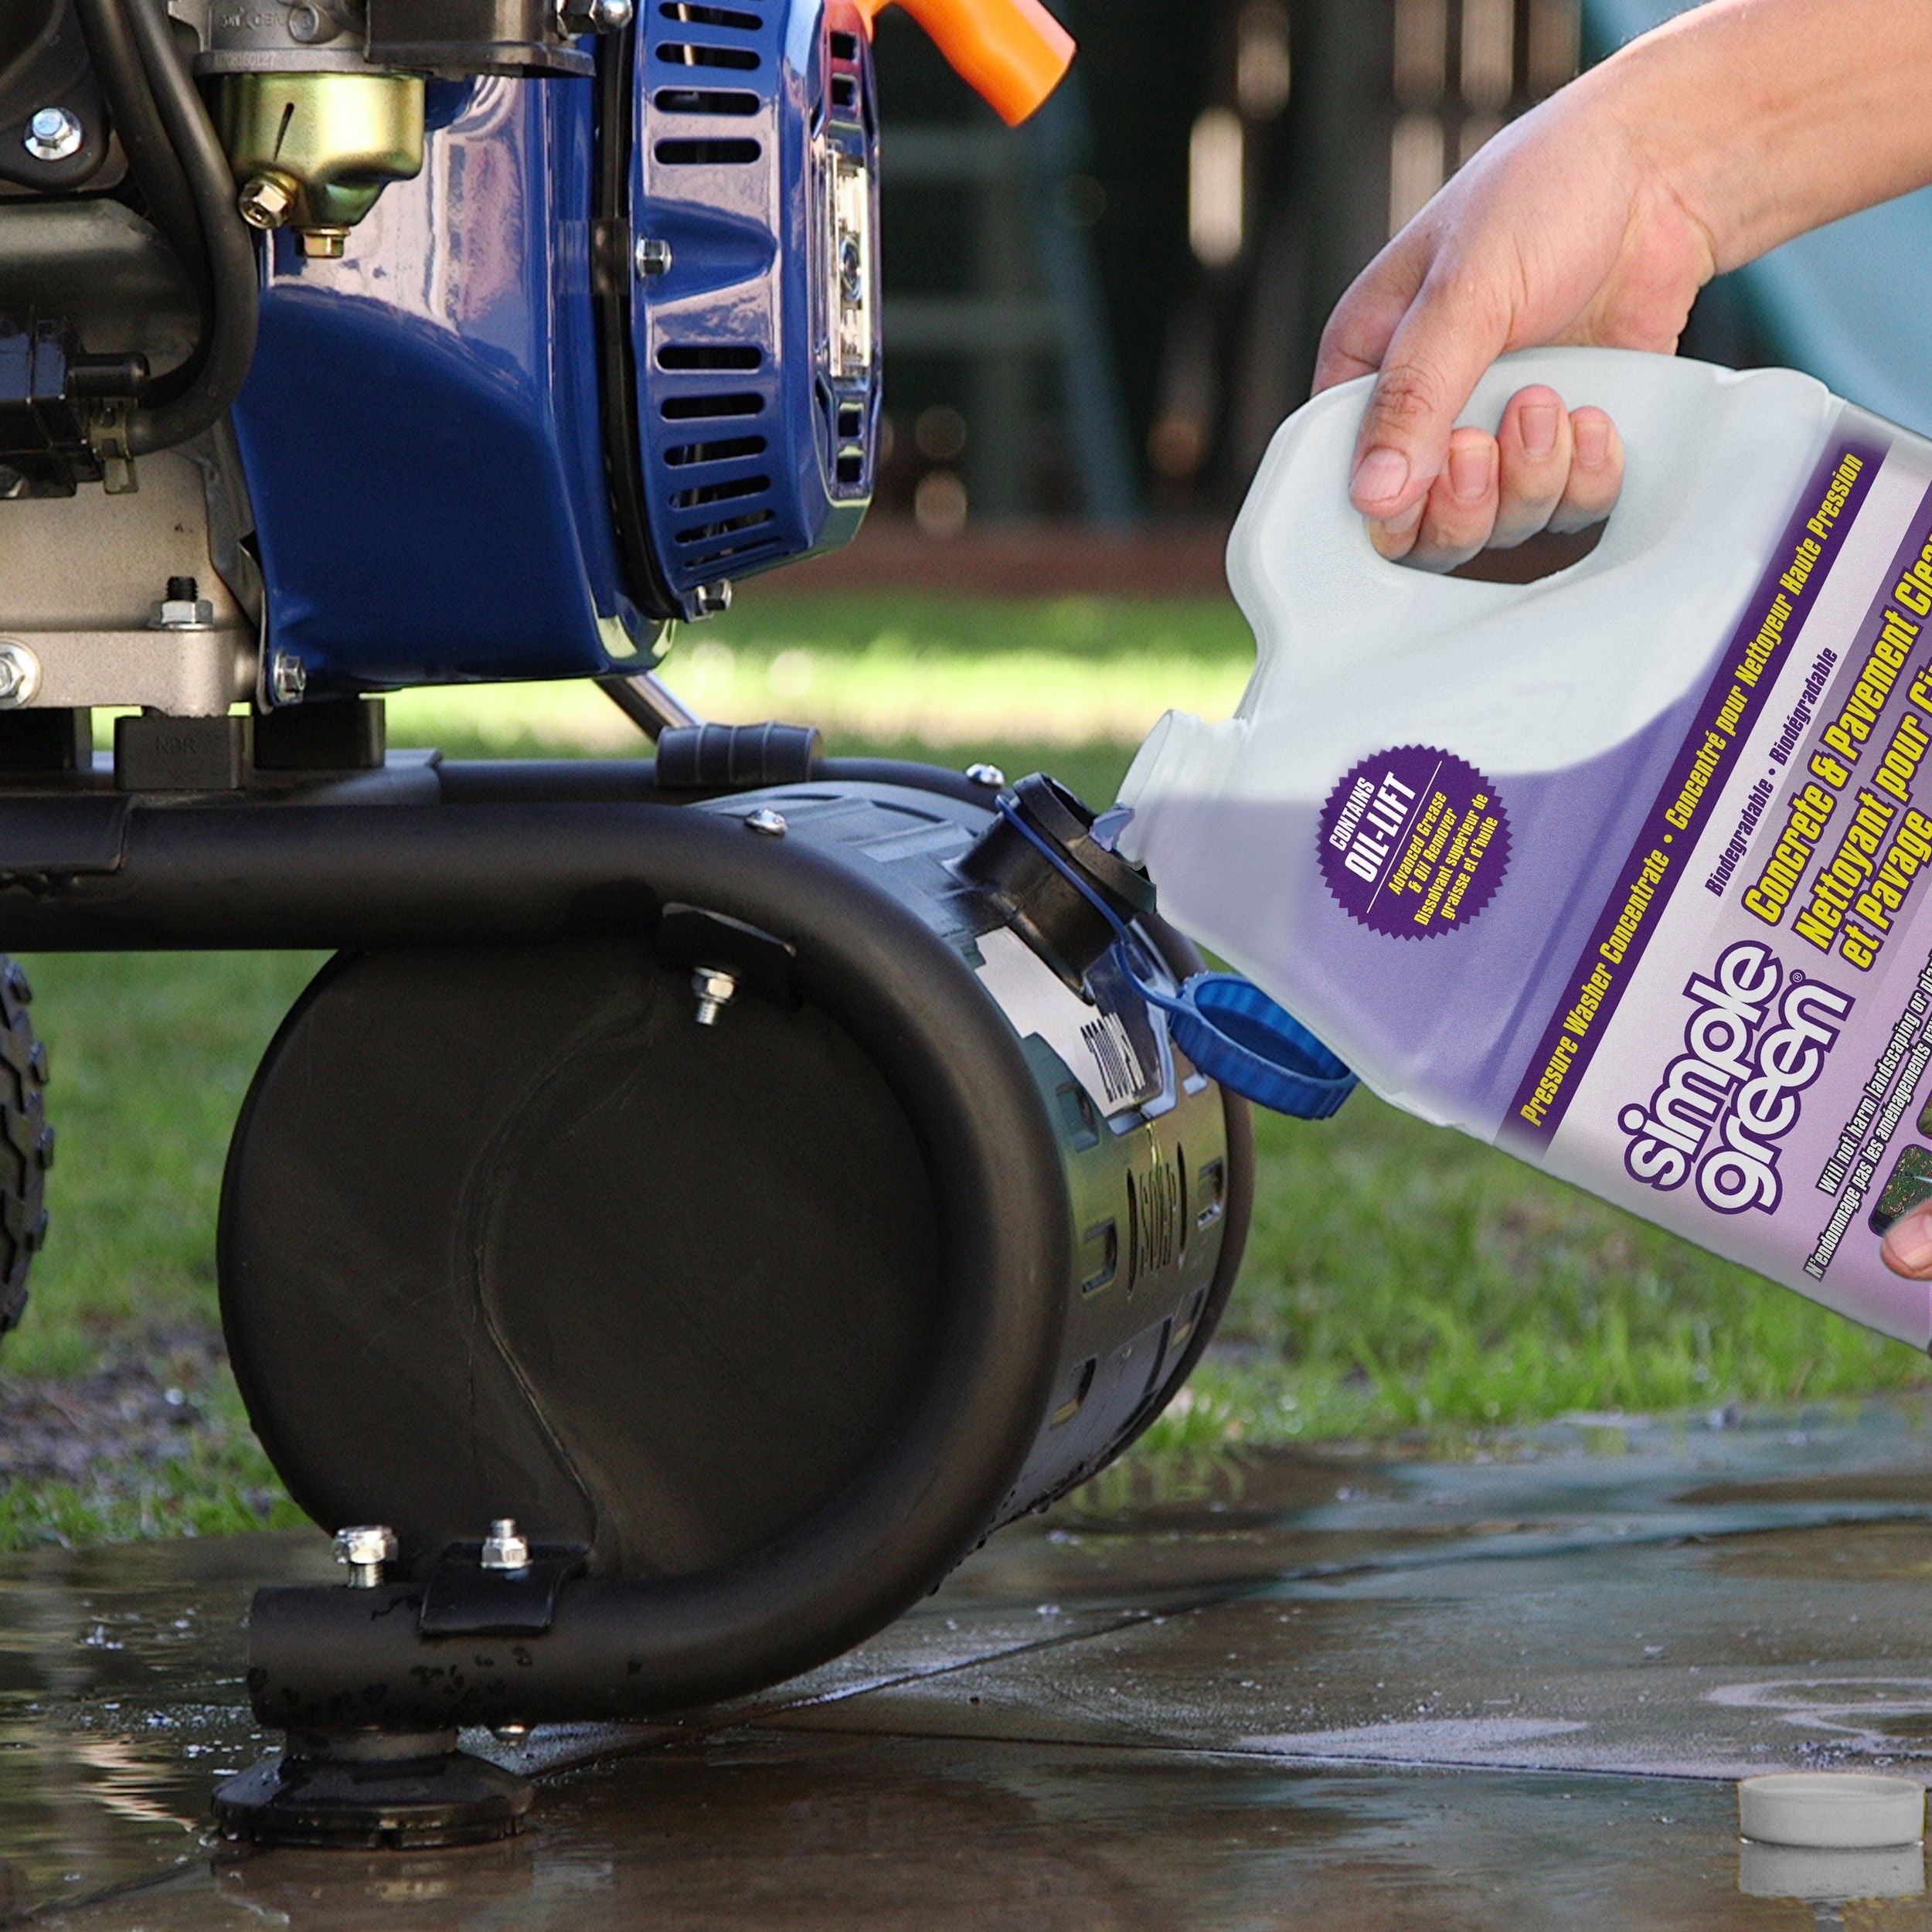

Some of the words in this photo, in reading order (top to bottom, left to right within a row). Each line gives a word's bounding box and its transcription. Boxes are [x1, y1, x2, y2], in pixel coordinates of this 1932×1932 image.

[1824, 611, 1918, 760] Pavement
[1329, 777, 1374, 851] CONTAINS
[1345, 771, 1415, 882] OIL-LIFT
[1521, 1036, 1578, 1125] Pressure
[1563, 963, 1612, 1036] Washer
[1600, 849, 1669, 964] Concentrate
[1665, 731, 1726, 830] Concentré
[1716, 685, 1747, 736] pour
[1735, 594, 1792, 687] Nettoyeur
[1780, 538, 1821, 595] Haute
[1807, 454, 1862, 539] Pression
[1705, 779, 1774, 897] Biodegradable
[1769, 648, 1838, 766] Biodégradable
[1796, 792, 1893, 949] Nettoyant
[1876, 715, 1929, 801] pour
[1811, 755, 1848, 787] &
[1388, 834, 1426, 895] Advanced
[1416, 791, 1447, 837] Grease
[1407, 880, 1423, 893] &
[1413, 865, 1454, 926] Dissolvant
[1444, 809, 1480, 867] supérieur
[1471, 794, 1488, 811] de
[1413, 860, 1432, 882] Oil
[1422, 808, 1457, 863] Remover
[1440, 872, 1471, 920] graisse
[1463, 857, 1478, 872] et
[1745, 785, 1834, 923] Concrete
[1855, 811, 1932, 929] Pavage
[1842, 924, 1879, 968] et
[1624, 946, 1777, 1187] simple
[1701, 985, 1848, 1209] green
[1818, 1161, 1845, 1194] Will
[1836, 1134, 1858, 1165] not
[1848, 1097, 1876, 1138] harm
[1866, 1012, 1920, 1099] landscaping
[1910, 992, 1927, 1013] or
[1852, 1162, 1872, 1190] pas
[1862, 1139, 1883, 1163] les
[1876, 1043, 1930, 1141] aménagements
